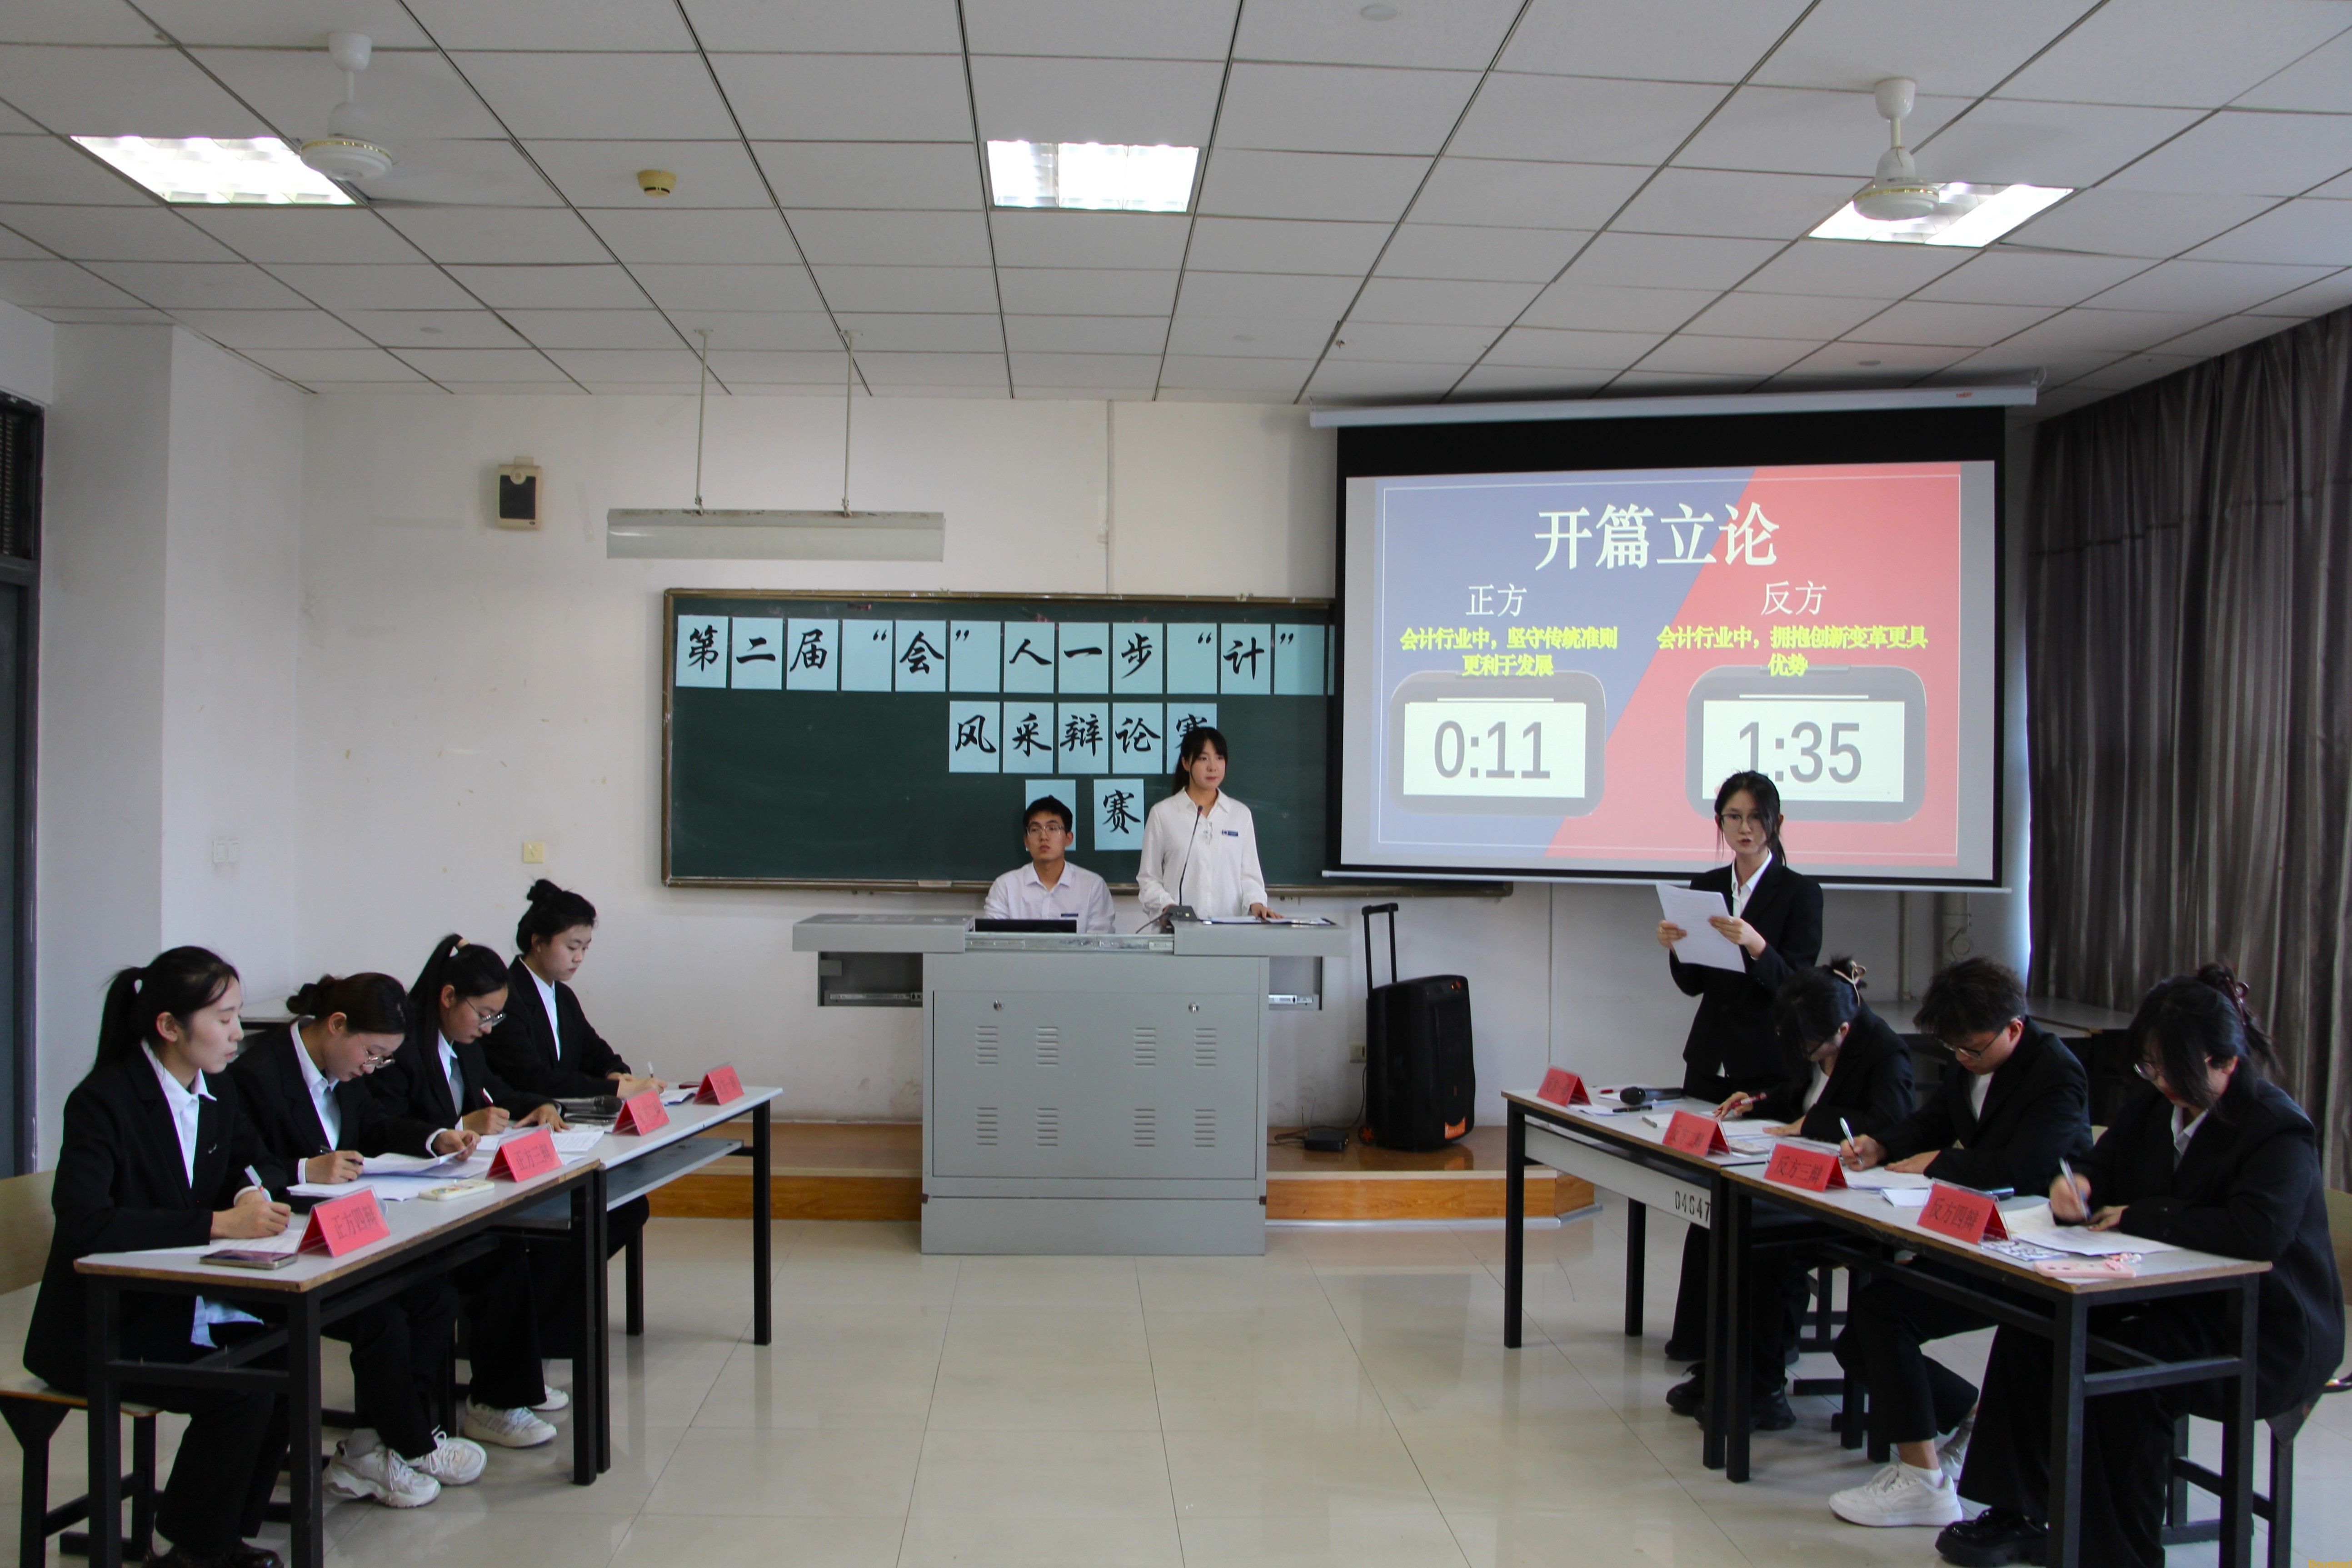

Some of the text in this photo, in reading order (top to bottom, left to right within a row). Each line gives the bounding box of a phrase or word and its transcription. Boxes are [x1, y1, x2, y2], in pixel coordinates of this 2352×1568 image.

[1534, 502, 1779, 570] 开篇立论
[1466, 583, 1527, 617] 正方
[1761, 580, 1827, 615] 反方
[1461, 654, 1554, 676] 更利于发展
[1768, 652, 1809, 677] 优势
[1434, 720, 1551, 779] 0:11
[1738, 720, 1863, 784] 1:35
[1675, 1190, 1710, 1223] 04647
